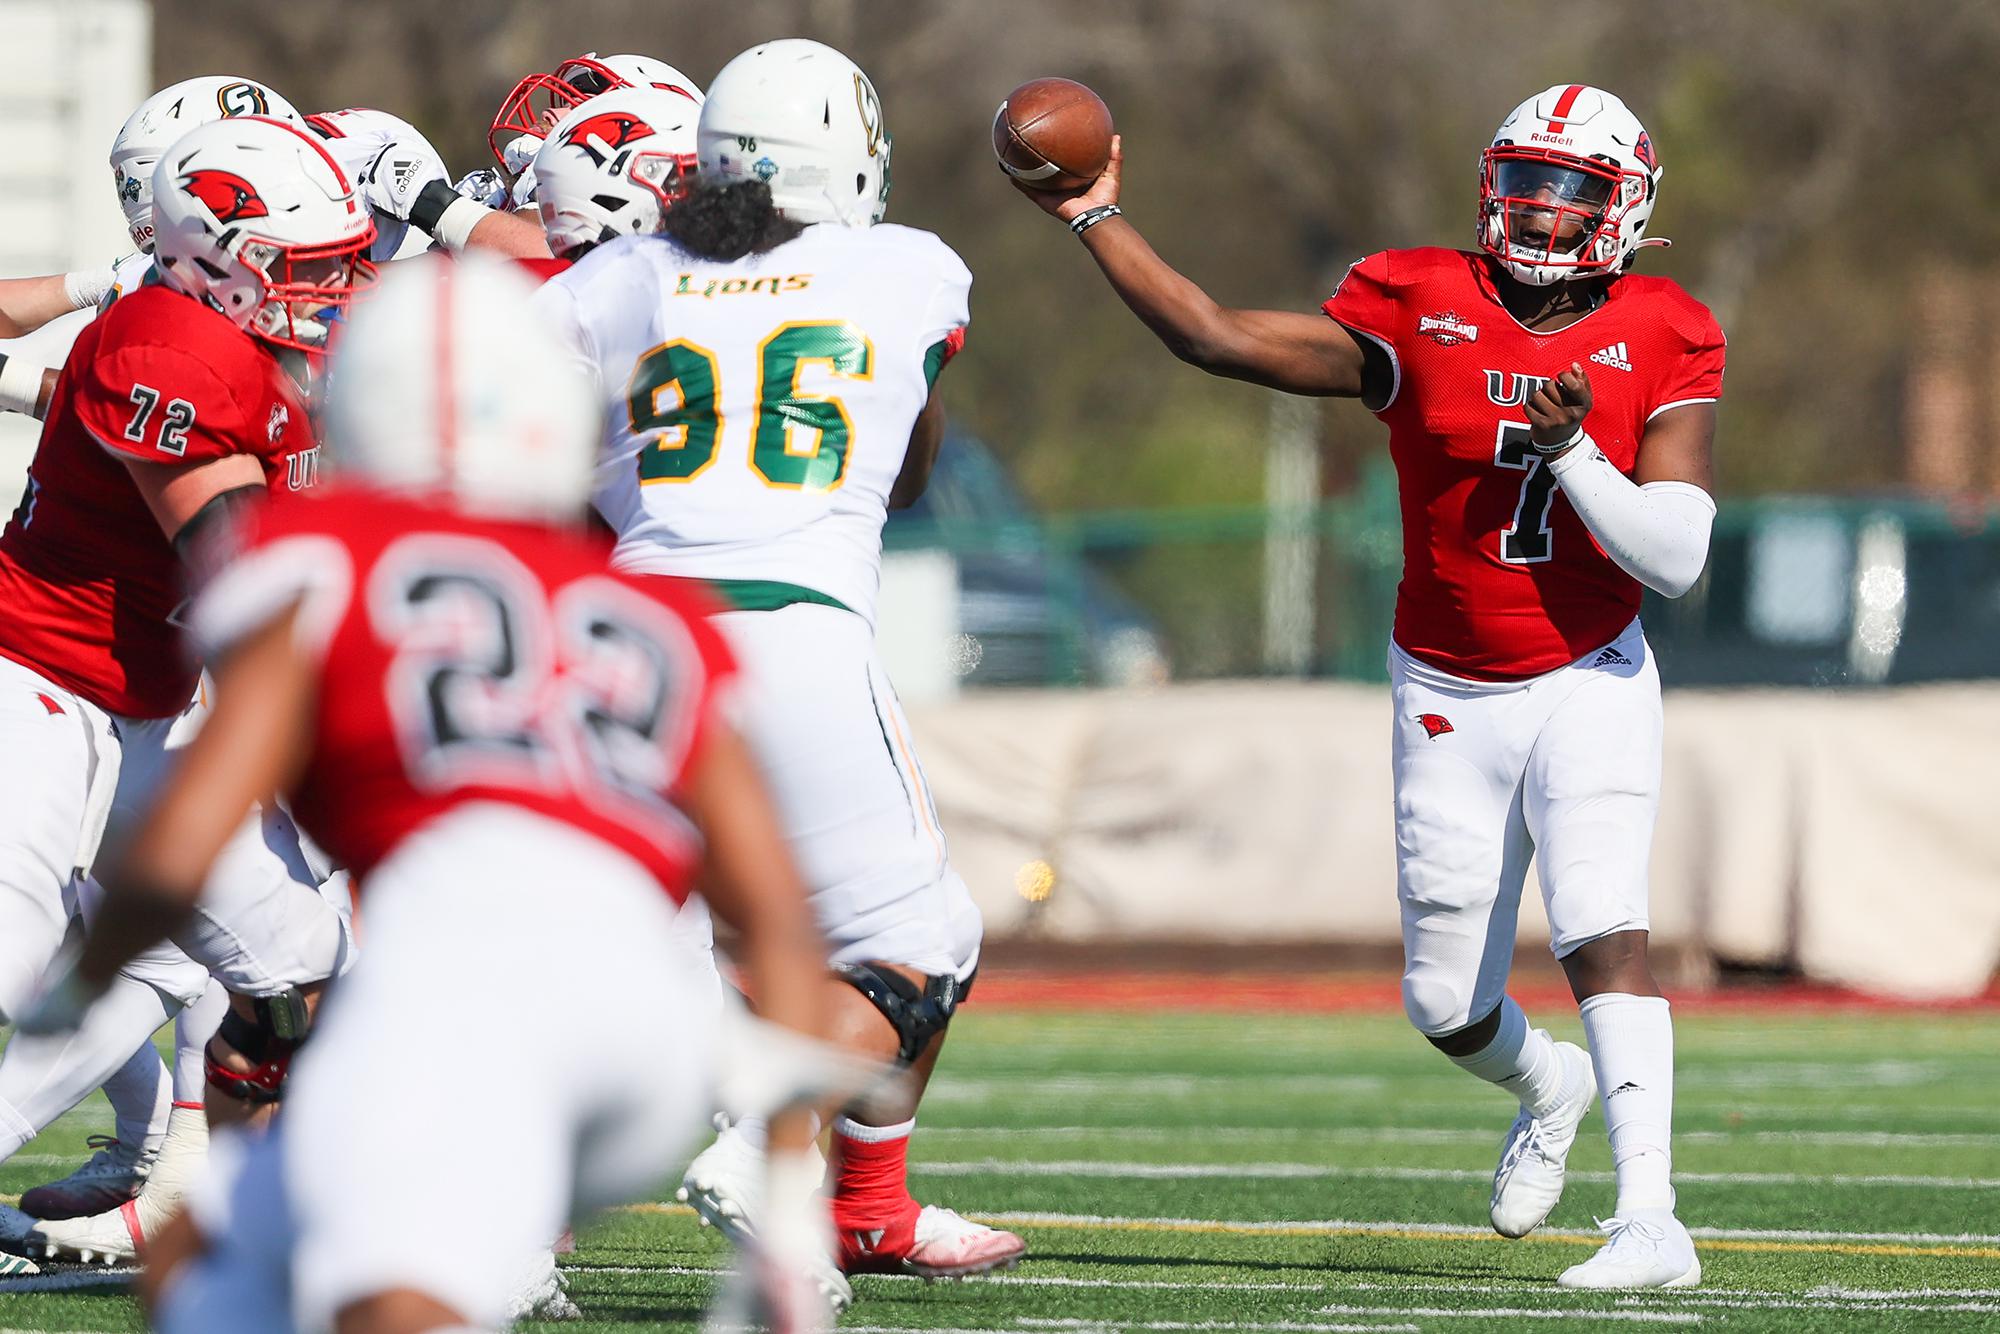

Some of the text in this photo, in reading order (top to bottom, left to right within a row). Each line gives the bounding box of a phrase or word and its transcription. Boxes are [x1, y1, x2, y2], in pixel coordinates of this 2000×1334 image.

[738, 136, 757, 152] 96
[1531, 133, 1574, 147] Riddell
[396, 159, 423, 194] adidas
[1516, 249, 1544, 260] Riddell
[672, 273, 816, 299] Lions
[1419, 316, 1478, 342] SOUTHLAND
[1590, 353, 1633, 372] adidas
[1482, 369, 1551, 407] UI
[626, 319, 875, 494] 96
[124, 383, 197, 457] 72
[1494, 419, 1559, 564] 7
[1594, 657, 1632, 667] adidas
[364, 530, 706, 860] 22
